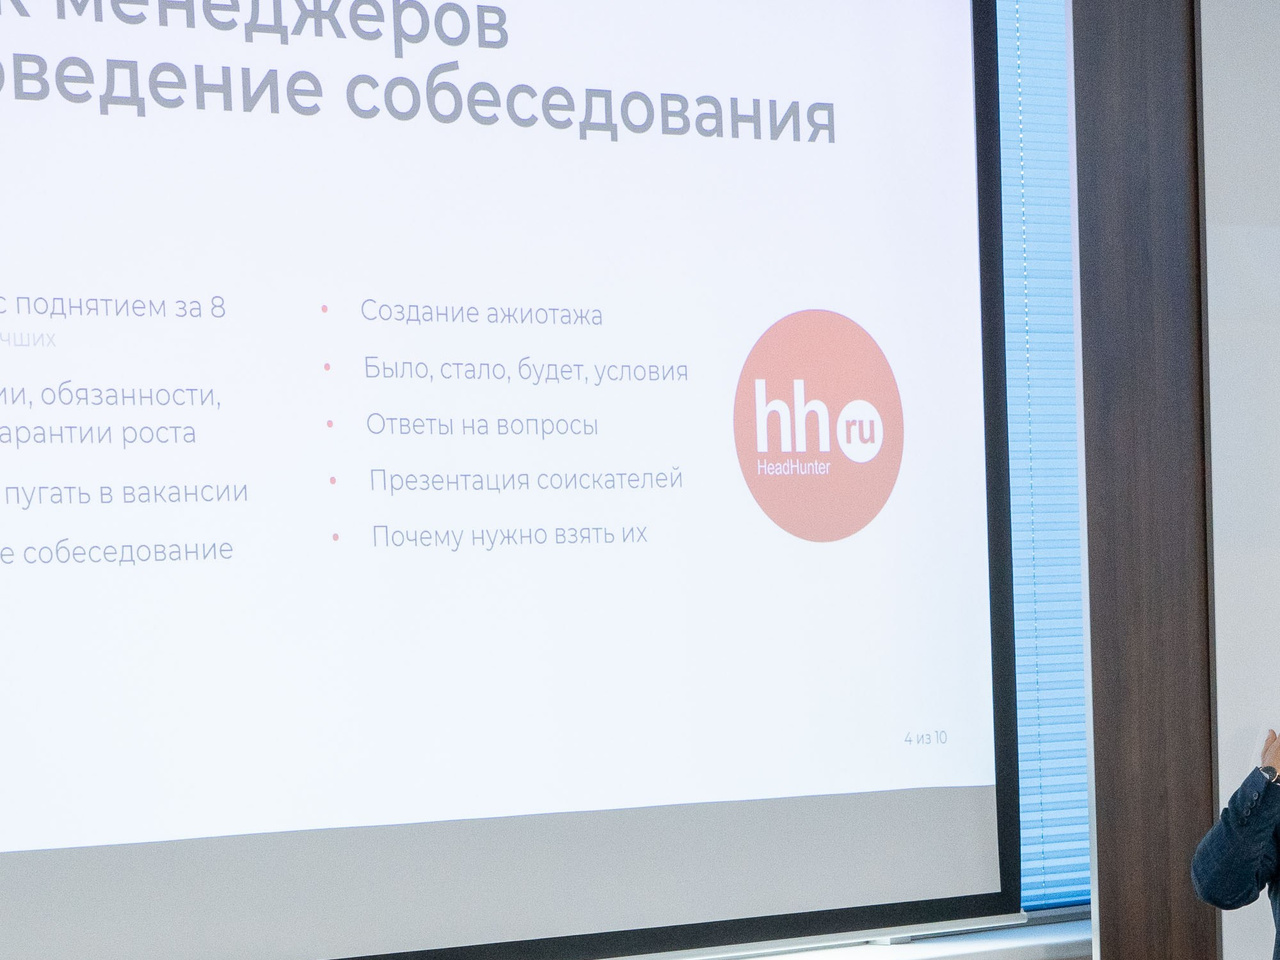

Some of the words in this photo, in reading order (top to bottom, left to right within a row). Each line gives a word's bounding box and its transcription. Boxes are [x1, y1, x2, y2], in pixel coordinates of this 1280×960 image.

[0, 53, 323, 117] ведение
[346, 61, 836, 143] собеседования
[17, 297, 165, 318] поднятием
[176, 300, 201, 317] за
[211, 296, 225, 318] 8
[361, 299, 479, 324] Создание
[487, 307, 602, 325] ажиотажа
[365, 356, 433, 381] Было,
[441, 362, 511, 384] стало,
[518, 356, 588, 385] будет,
[594, 365, 687, 386] условия
[41, 380, 220, 409] обязанности,
[367, 413, 453, 435] Ответы
[463, 419, 488, 435] на
[498, 419, 597, 440] вопросы
[755, 379, 831, 453] hh
[845, 419, 875, 444] ru
[123, 426, 195, 449] роста
[371, 469, 529, 496] Презентация
[537, 466, 683, 490] соискателей
[757, 459, 831, 476] HeadHunter
[6, 486, 90, 510] пугать
[100, 486, 113, 503] в
[123, 485, 247, 503] вакансии
[24, 538, 233, 565] собеседование
[373, 525, 463, 552] Почему
[472, 528, 547, 551] нужно
[556, 527, 615, 544] взять
[623, 527, 647, 542] их
[904, 732, 913, 745] 4
[916, 734, 932, 745] из
[934, 730, 948, 744] 10
